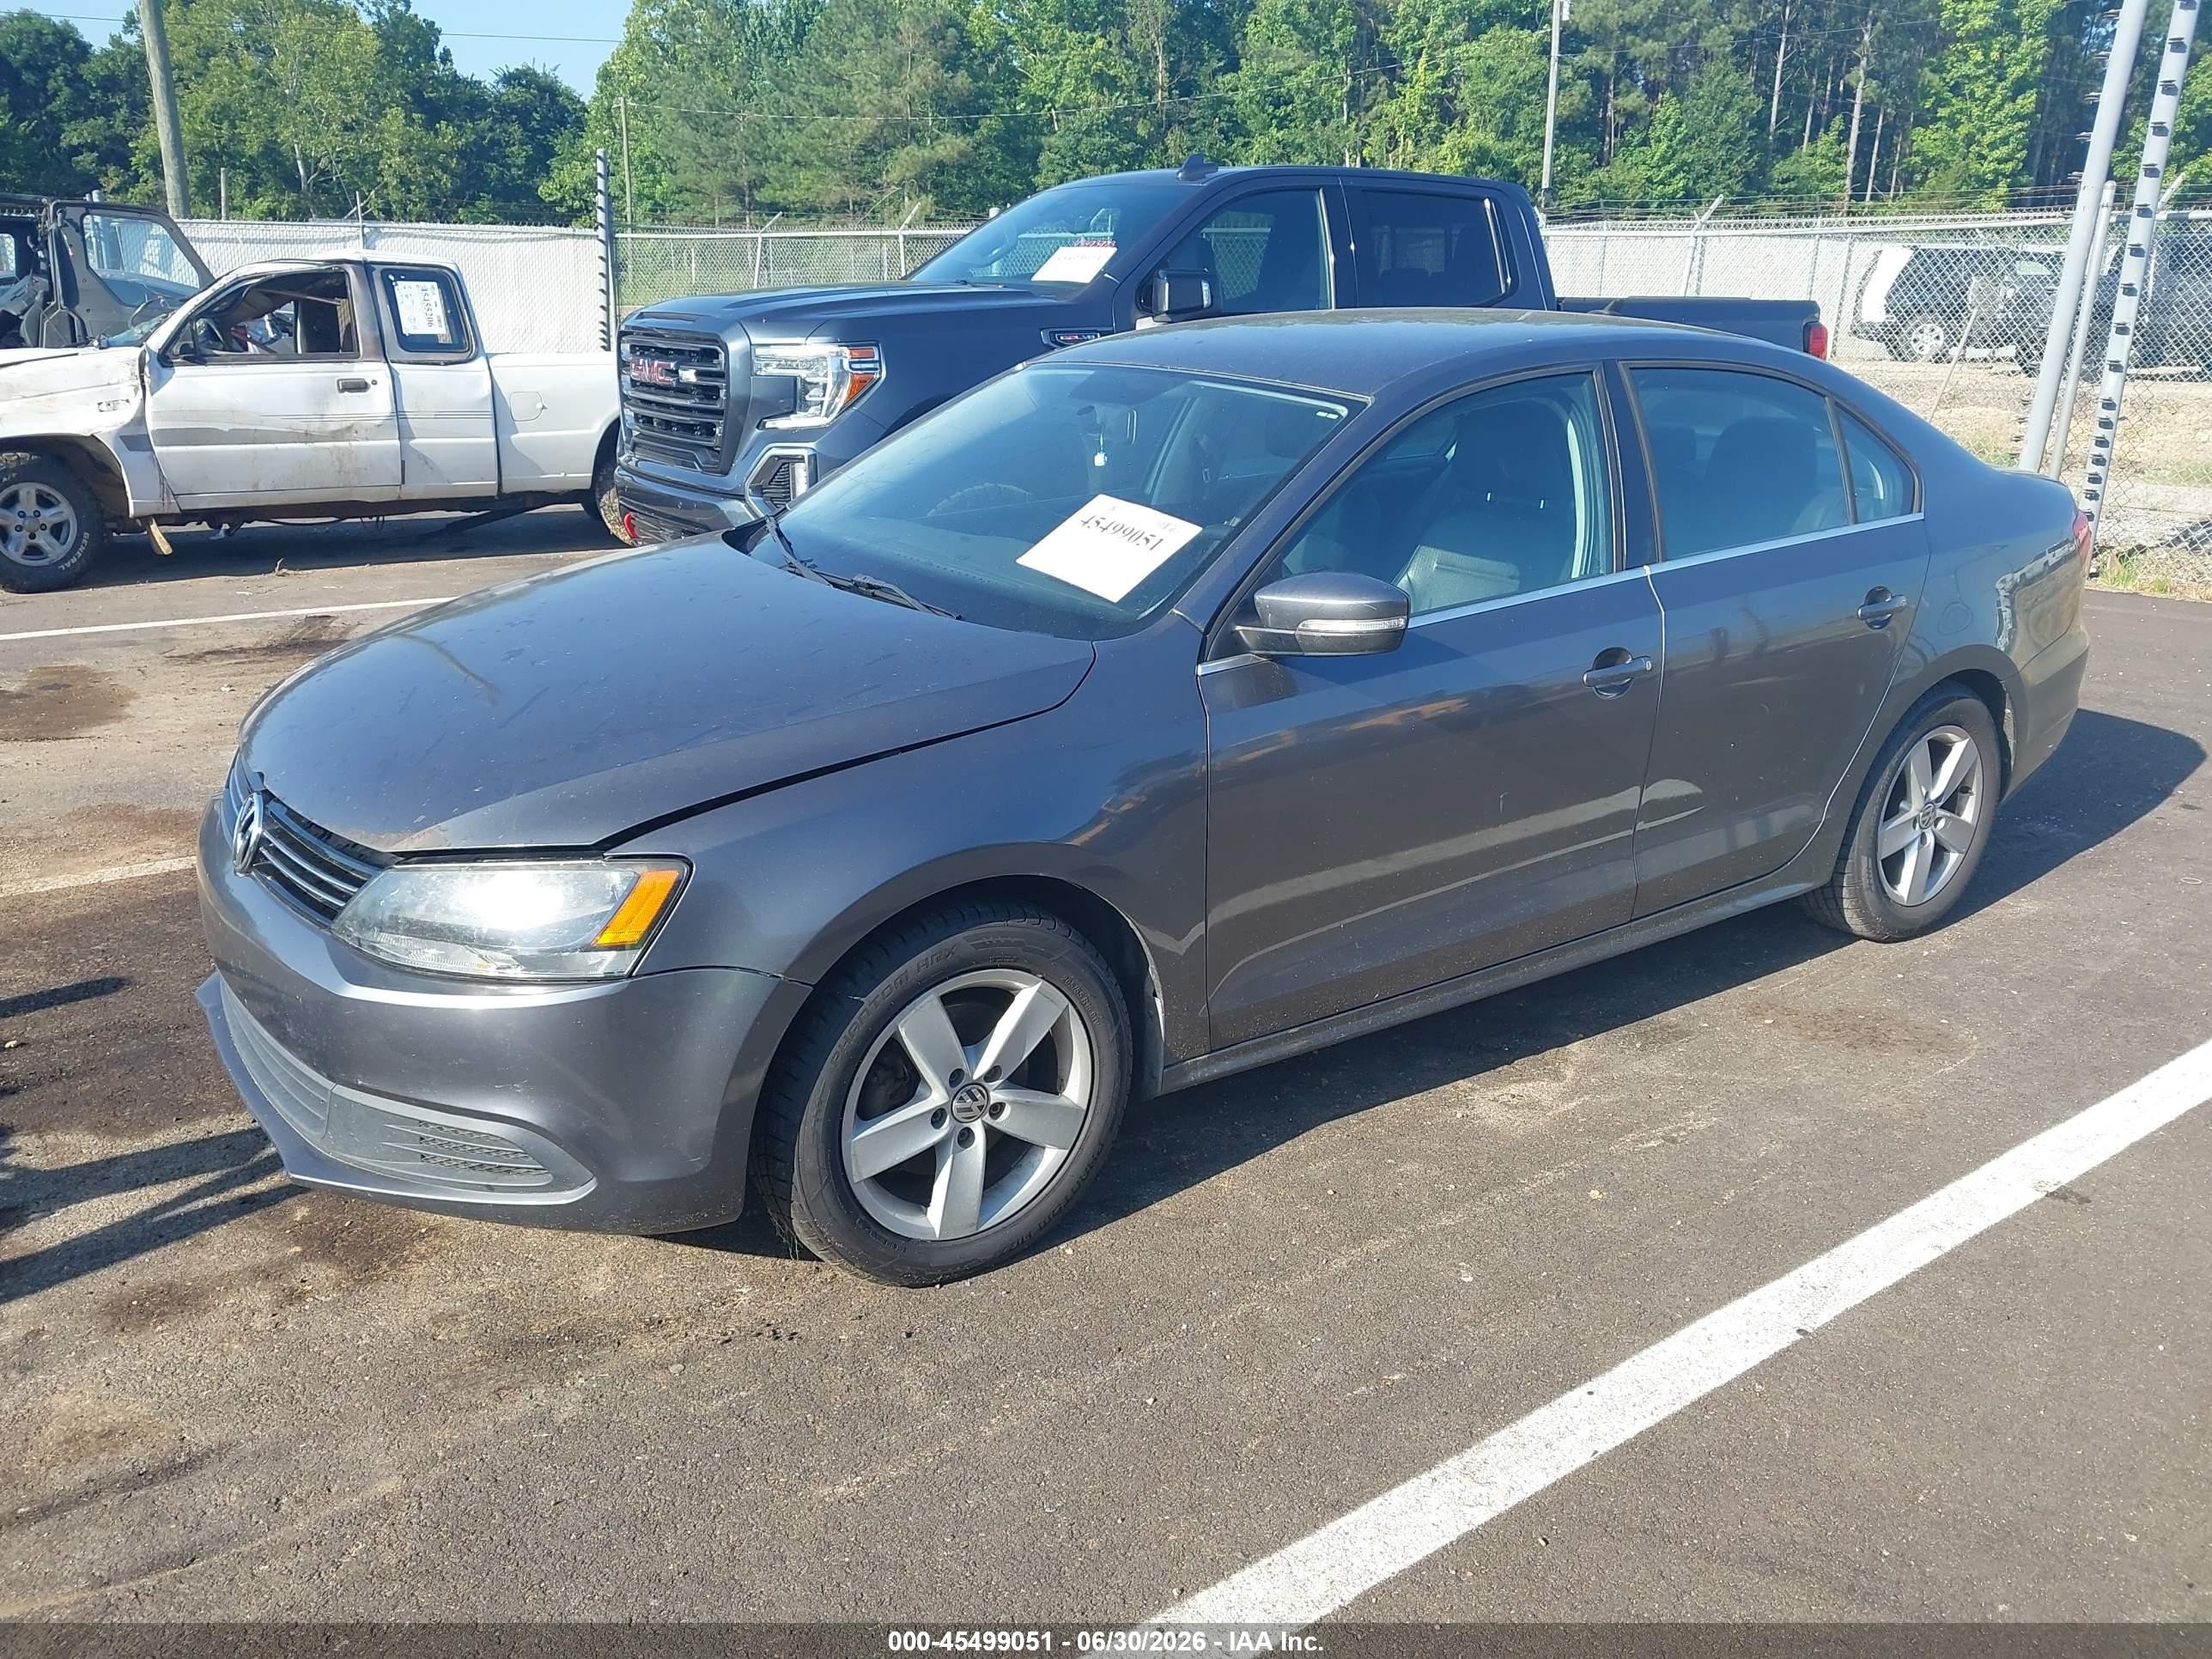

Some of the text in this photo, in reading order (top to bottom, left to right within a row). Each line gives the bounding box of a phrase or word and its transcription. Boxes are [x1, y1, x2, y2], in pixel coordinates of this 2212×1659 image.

[630, 357, 678, 386] GMC
[1080, 515, 1164, 550] 45499051
[58, 532, 90, 571] GENERAL
